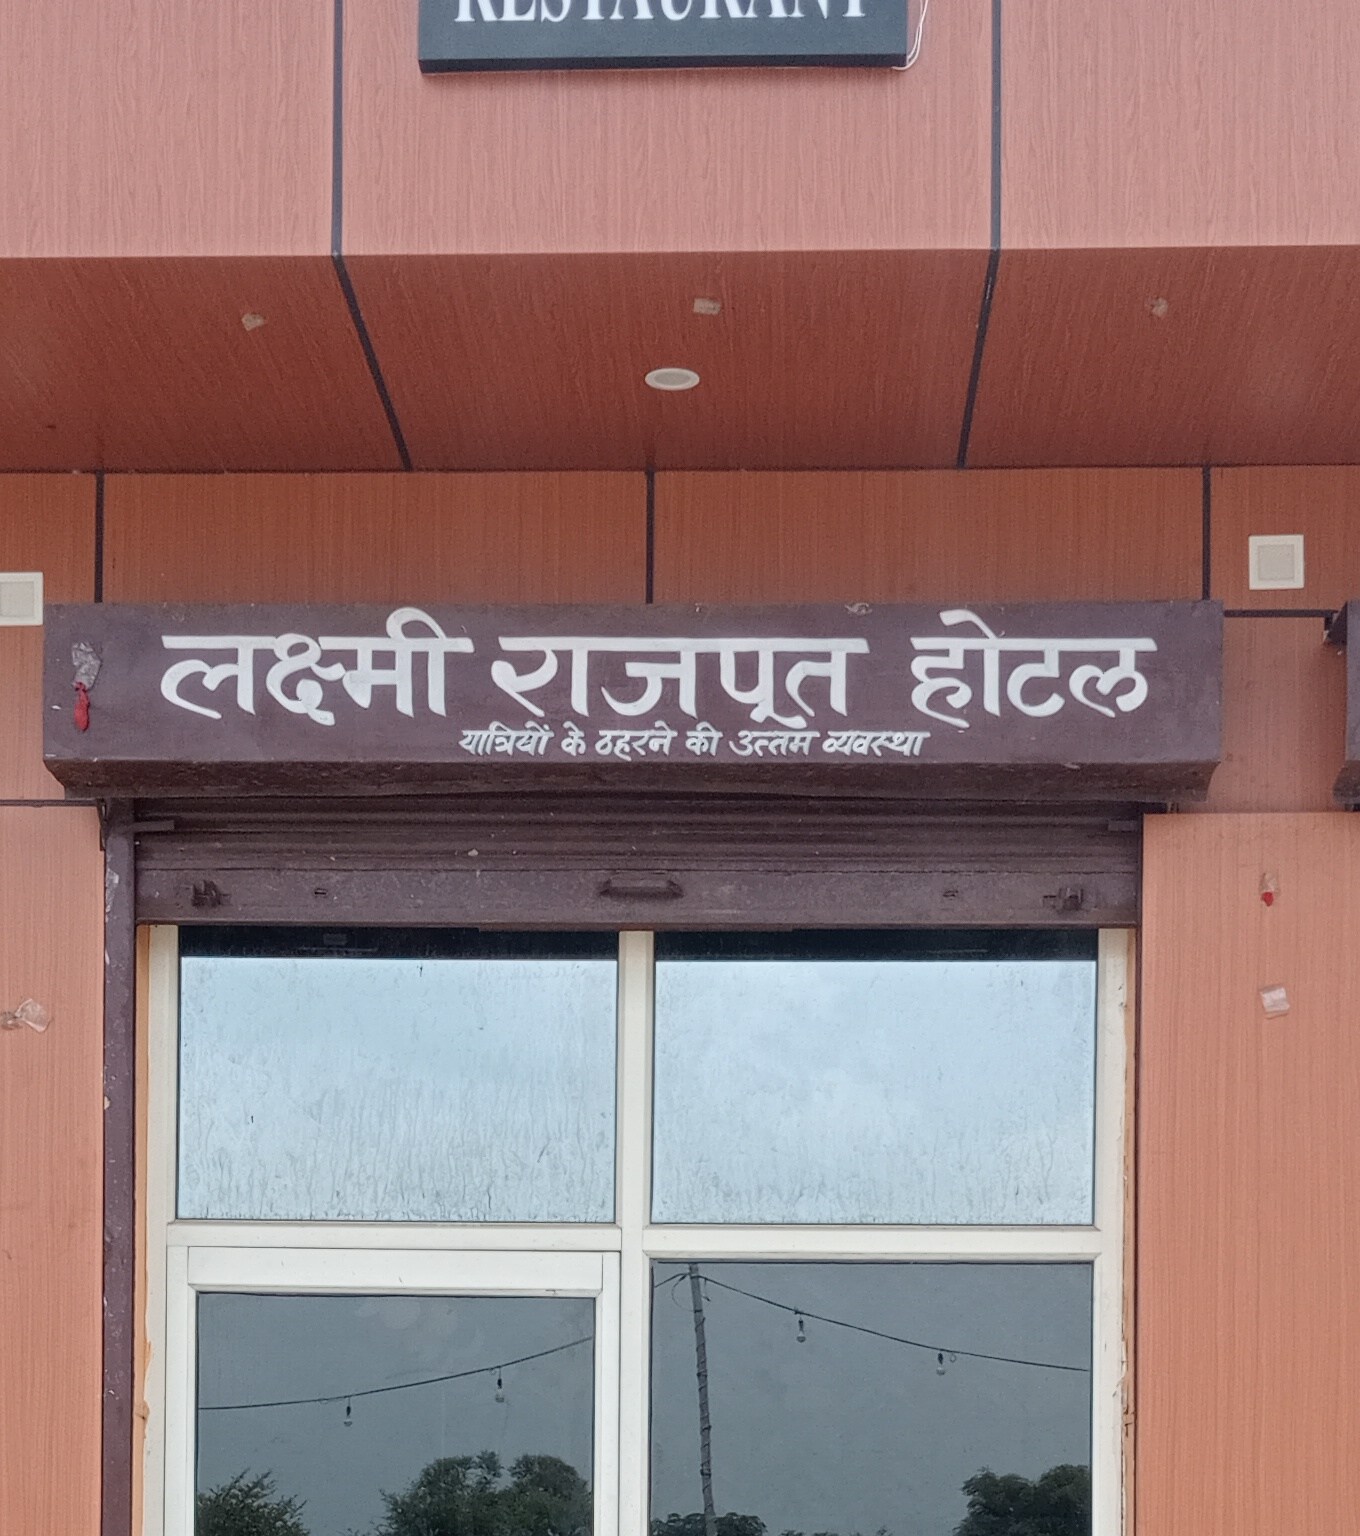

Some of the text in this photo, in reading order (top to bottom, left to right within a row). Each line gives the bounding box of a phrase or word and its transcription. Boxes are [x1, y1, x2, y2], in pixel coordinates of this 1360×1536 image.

[160, 606, 1158, 730] लक्ष्मी राजपूत होटल
[458, 719, 932, 762] यात्रियों के ठहरने की उत्तम व्यवस्था
